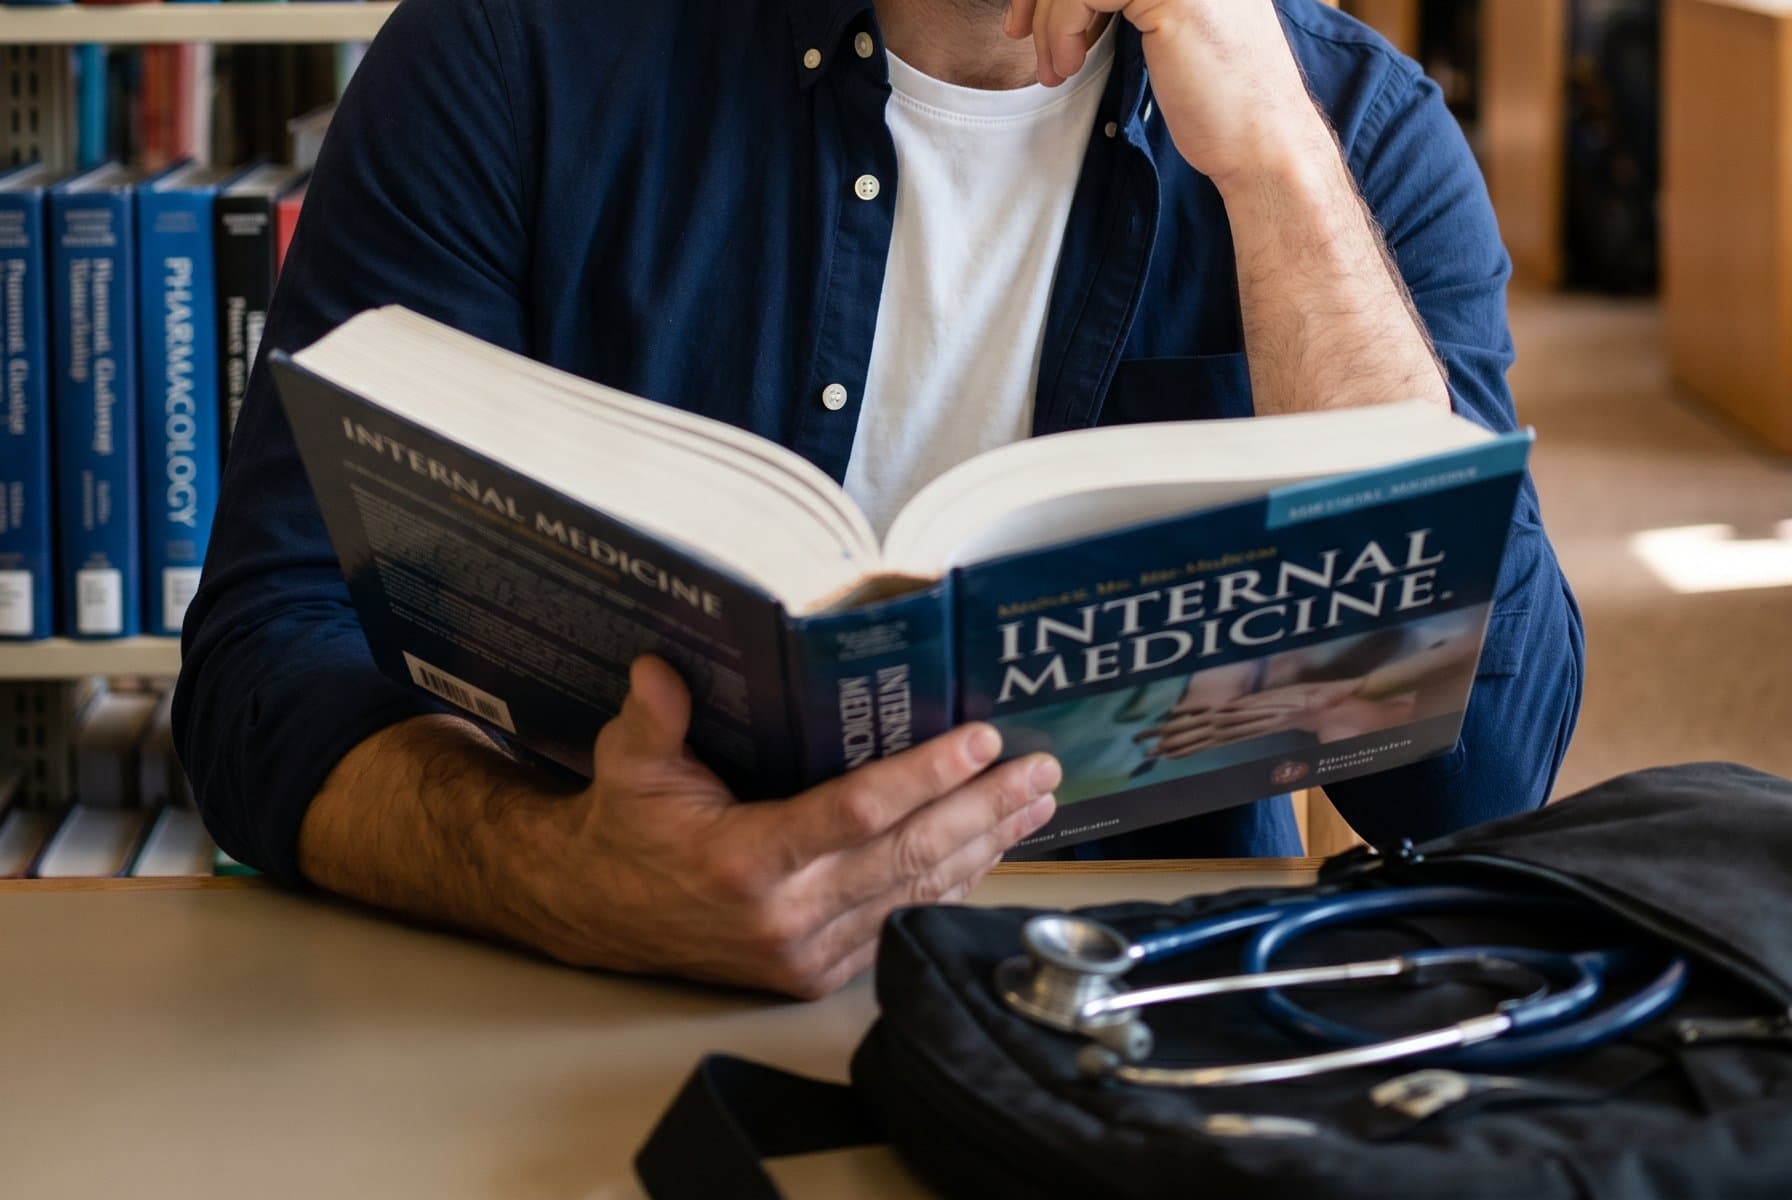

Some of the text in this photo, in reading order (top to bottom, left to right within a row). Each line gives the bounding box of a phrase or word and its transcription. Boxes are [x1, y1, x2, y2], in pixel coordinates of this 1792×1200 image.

[165, 257, 197, 527] PHARMACOLOGY
[341, 416, 722, 618] INTERNAL MEDICINE
[1000, 528, 1446, 662] INTERNAL
[838, 675, 874, 768] MEDICIN
[877, 663, 912, 757] INTERNA
